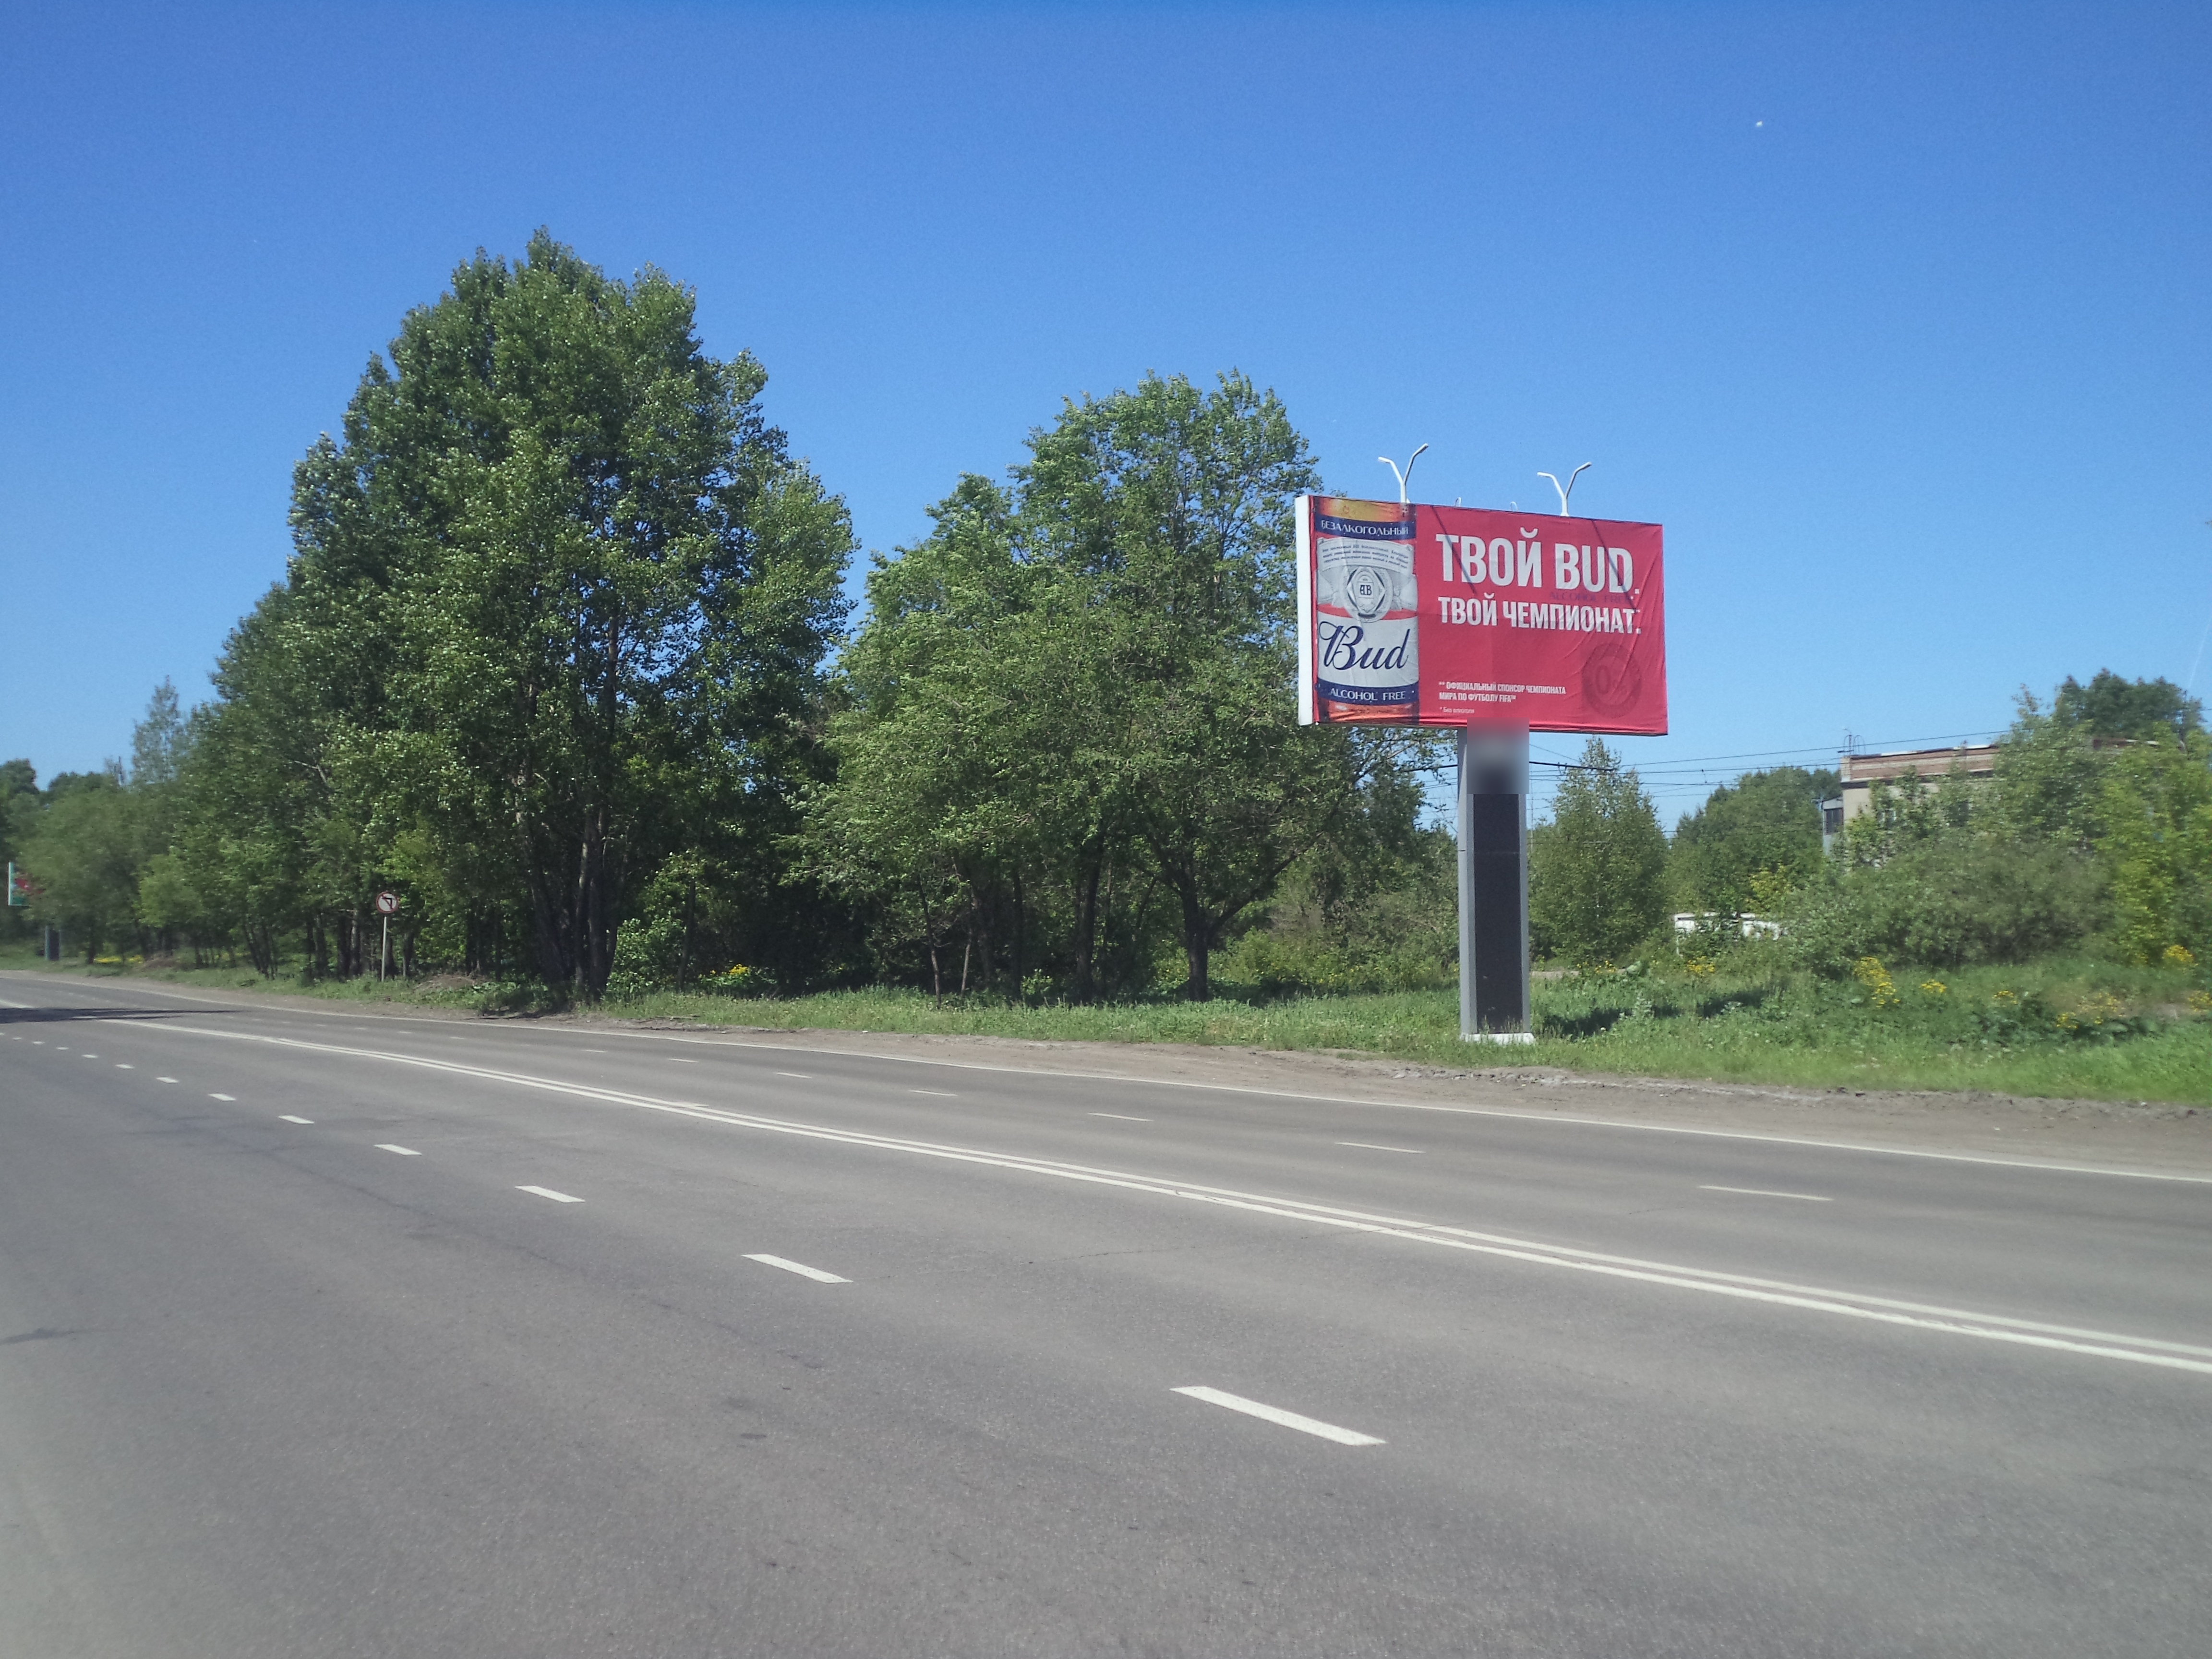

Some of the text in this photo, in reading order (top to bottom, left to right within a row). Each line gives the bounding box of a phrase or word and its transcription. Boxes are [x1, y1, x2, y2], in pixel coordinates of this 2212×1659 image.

[1321, 520, 1409, 535] БЕЗАЛКОГОЛЬНЫЙ
[1436, 527, 1640, 594] ТВОЙ BUD.
[1438, 592, 1497, 626] ТВОЙ
[1319, 621, 1410, 670] Bud
[1330, 688, 1406, 700] ALCOHOL FREE
[1446, 682, 1566, 694] ОФИЦИАЛЬНЫЙ СПОНСОР ЧЕМПИОНАТА
[1439, 692, 1457, 700] МИРА
[1468, 693, 1498, 702] ФУТБОЛУ
